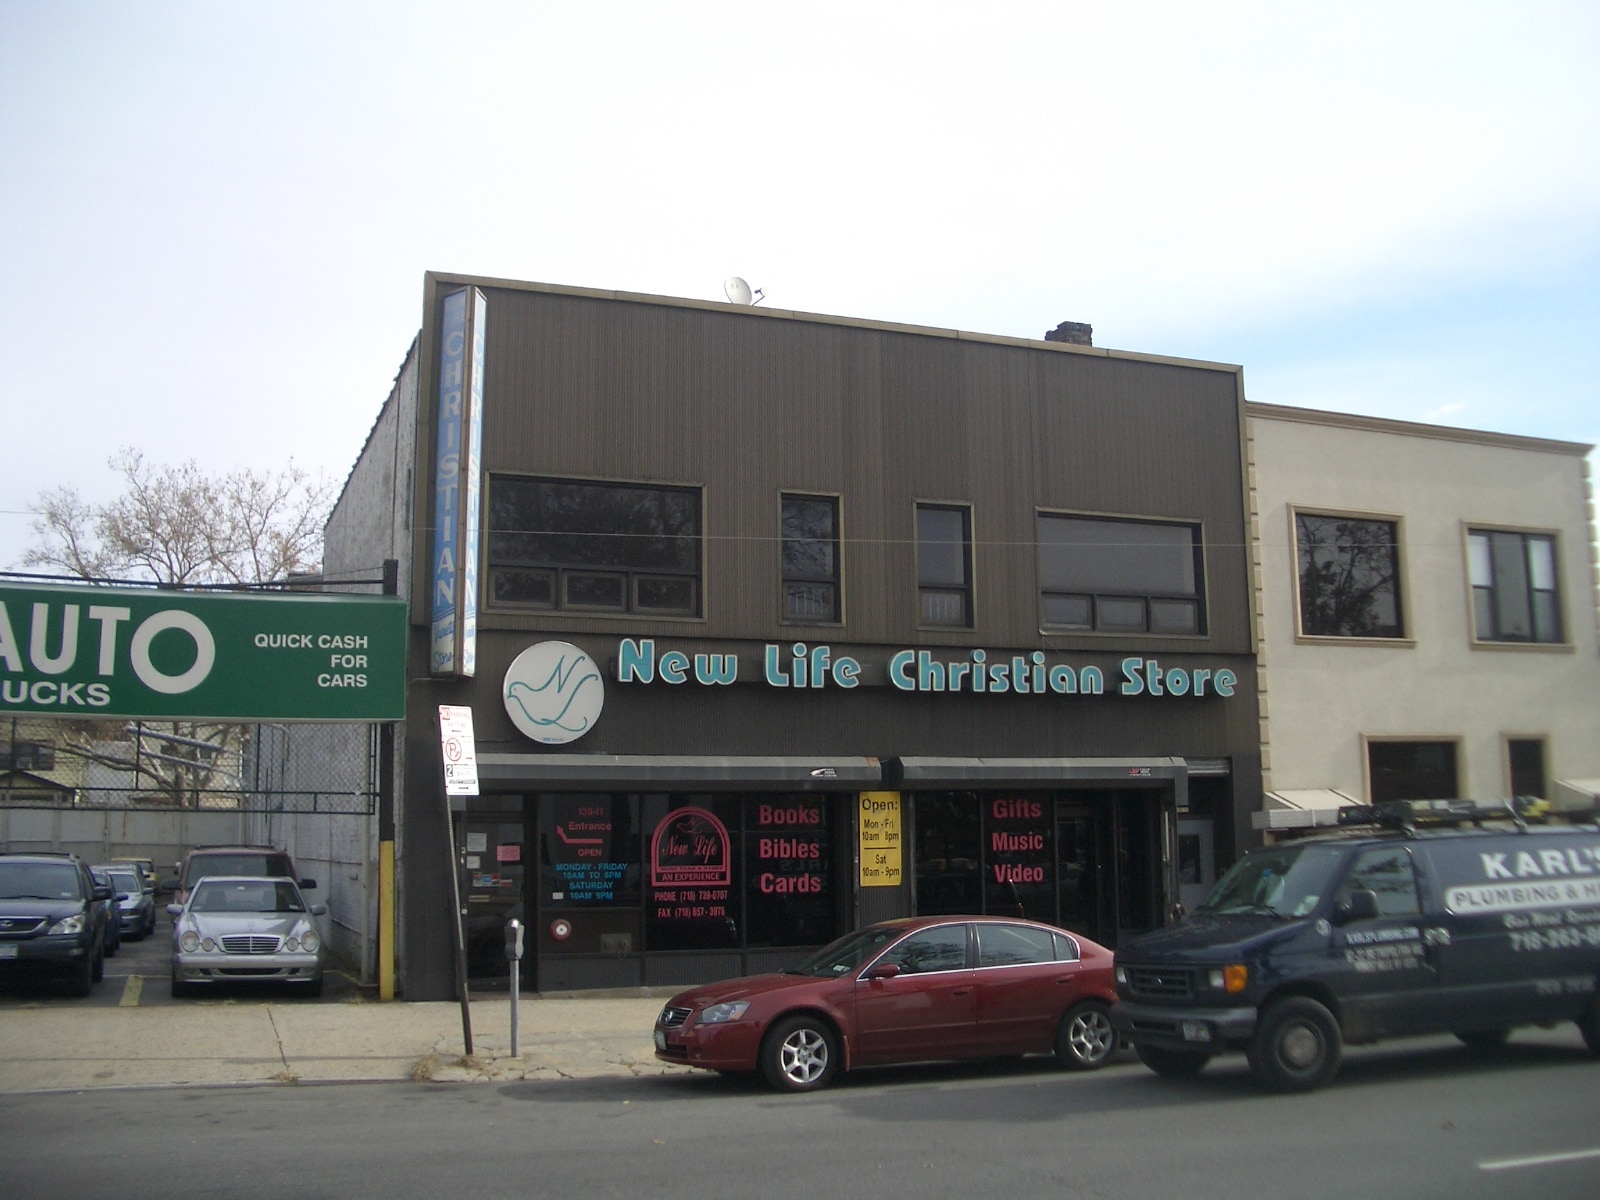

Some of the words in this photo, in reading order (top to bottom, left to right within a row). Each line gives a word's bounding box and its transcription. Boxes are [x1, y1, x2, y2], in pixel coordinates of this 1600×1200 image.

[437, 330, 464, 607] CHRISTIAN
[254, 633, 313, 649] QUICK
[318, 634, 368, 649] CASH
[330, 654, 368, 668] FOR
[618, 638, 738, 686] New
[765, 642, 862, 689] Life
[889, 649, 1104, 695] Christian
[1120, 657, 1238, 697] Store
[317, 673, 368, 688] CARS
[2, 681, 111, 706] UCKS
[862, 798, 898, 813] Open:
[992, 799, 1042, 819] Gifts
[759, 804, 820, 825] Books
[568, 821, 612, 831] Entrance
[864, 819, 879, 829] Mon
[885, 818, 894, 828] Fri
[862, 831, 879, 841] 10am
[992, 832, 1044, 851] Music
[578, 848, 602, 857] OPEN
[662, 835, 689, 856] New
[694, 834, 718, 865] Life
[759, 838, 820, 858] Bibles
[875, 854, 887, 864] Sat
[555, 863, 591, 871] MONDAY
[598, 863, 628, 871] FRIDAY
[862, 867, 879, 877] 10am
[885, 866, 900, 878] 9pm
[994, 864, 1044, 883] Video
[562, 871, 585, 879] 10AM
[589, 871, 600, 879] TO
[662, 873, 673, 881] AN
[674, 872, 720, 881] EXPERIENCE
[760, 872, 821, 893] Cards
[569, 881, 613, 889] SATURDAY
[654, 891, 677, 901] PHONE
[1454, 886, 1560, 906] PLUMBING
[657, 907, 672, 918] FAX
